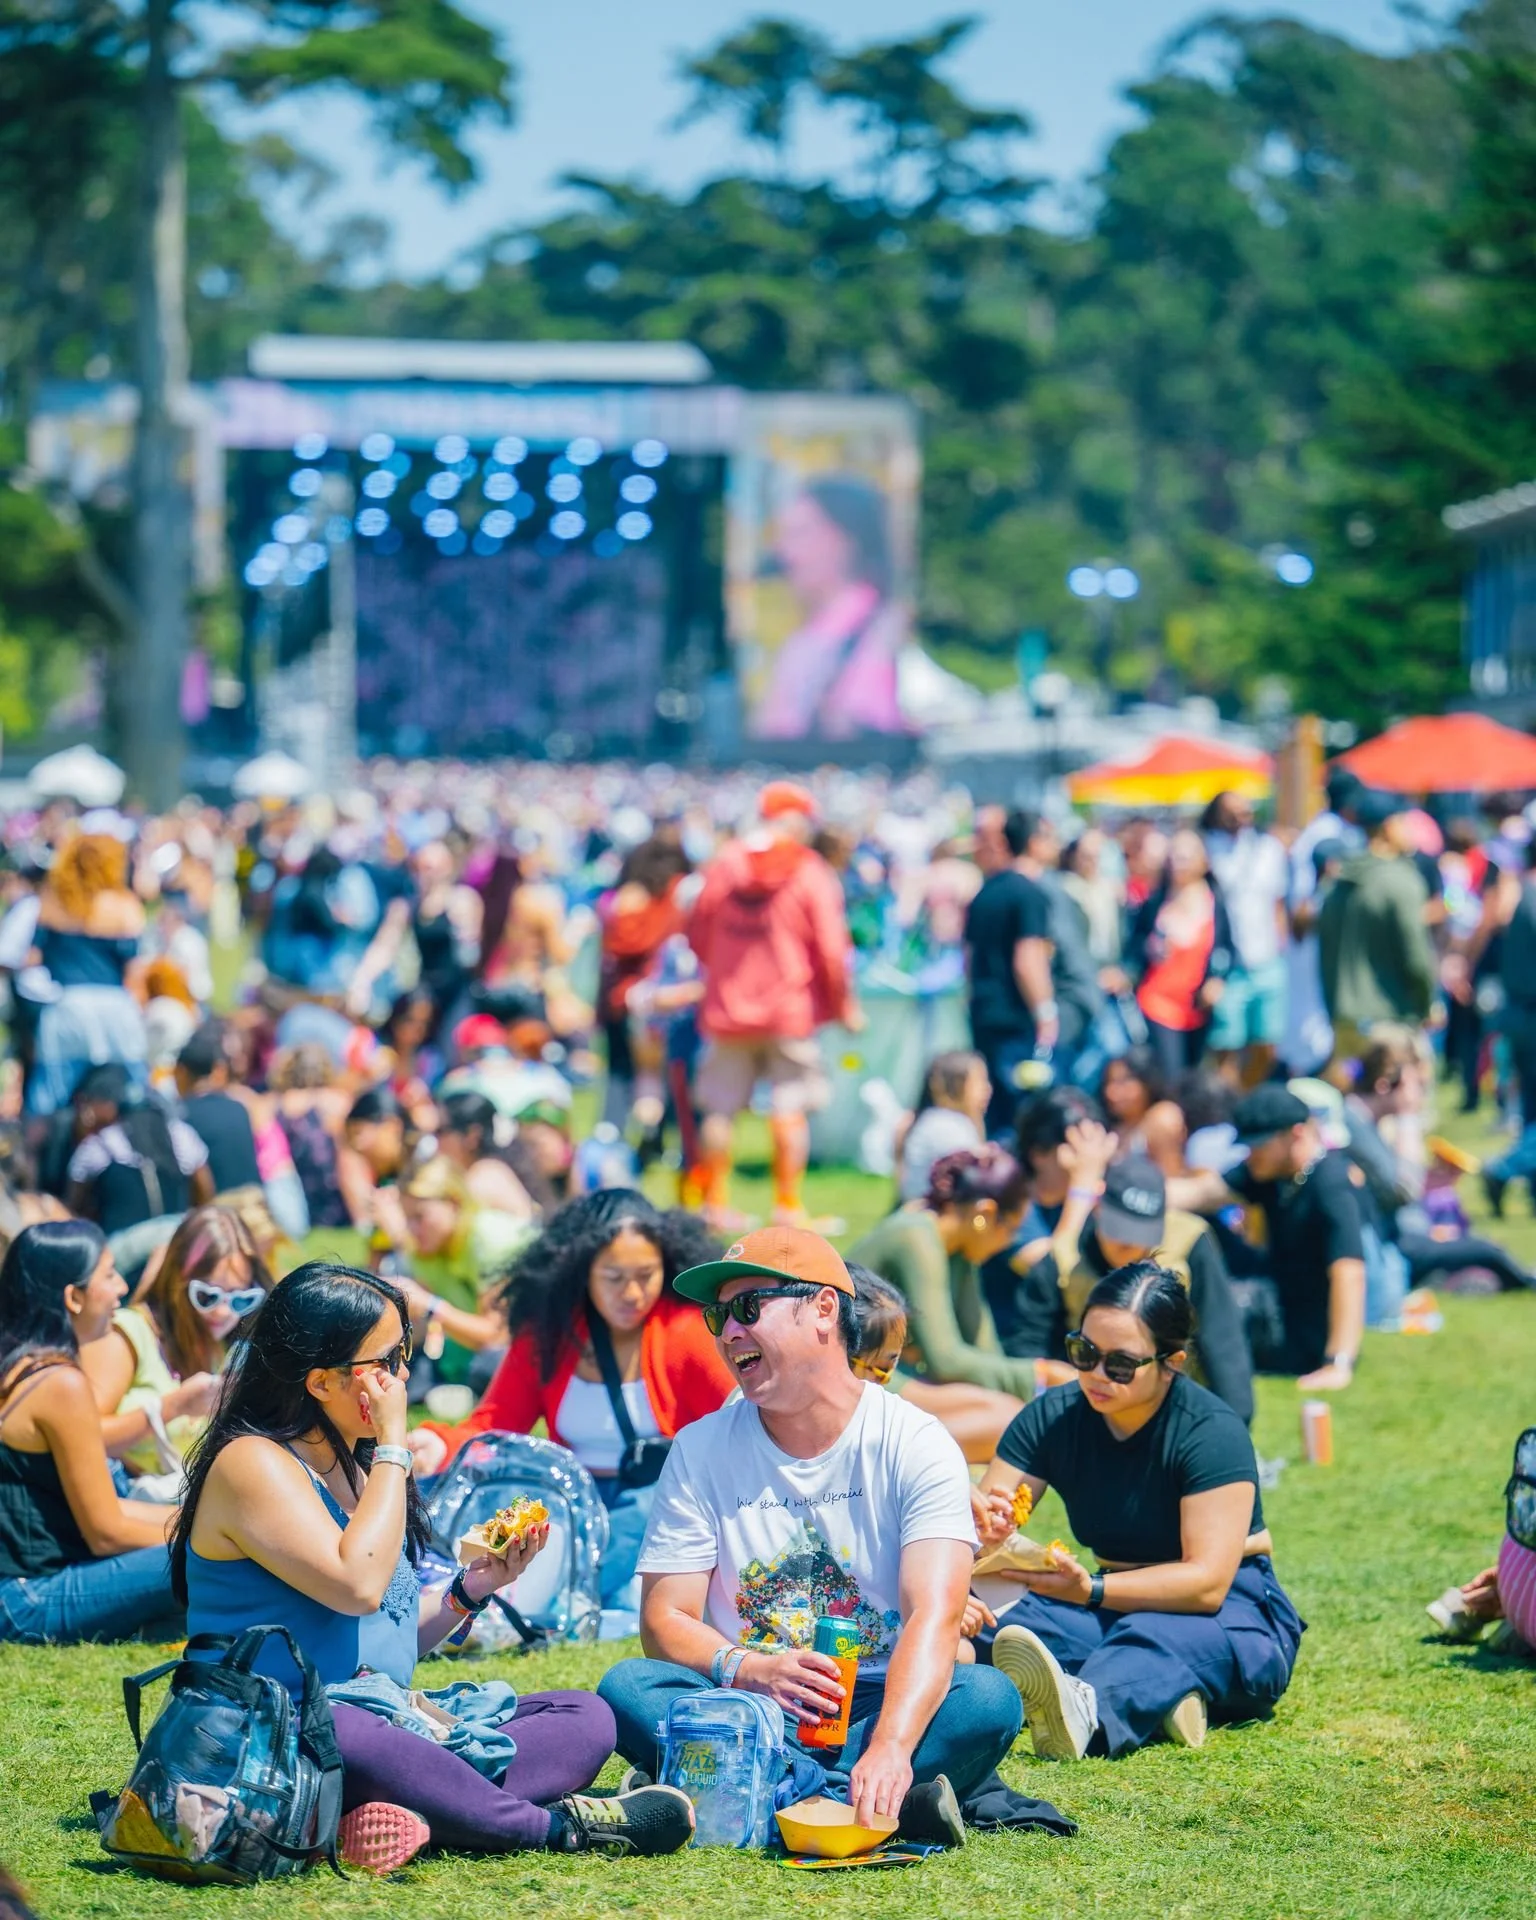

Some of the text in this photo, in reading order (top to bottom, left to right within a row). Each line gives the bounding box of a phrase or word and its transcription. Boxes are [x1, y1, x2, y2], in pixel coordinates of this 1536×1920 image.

[737, 1496, 753, 1509] We
[760, 1497, 789, 1510] stand
[822, 1487, 864, 1505] Ukraine
[858, 1660, 880, 1668] 022
